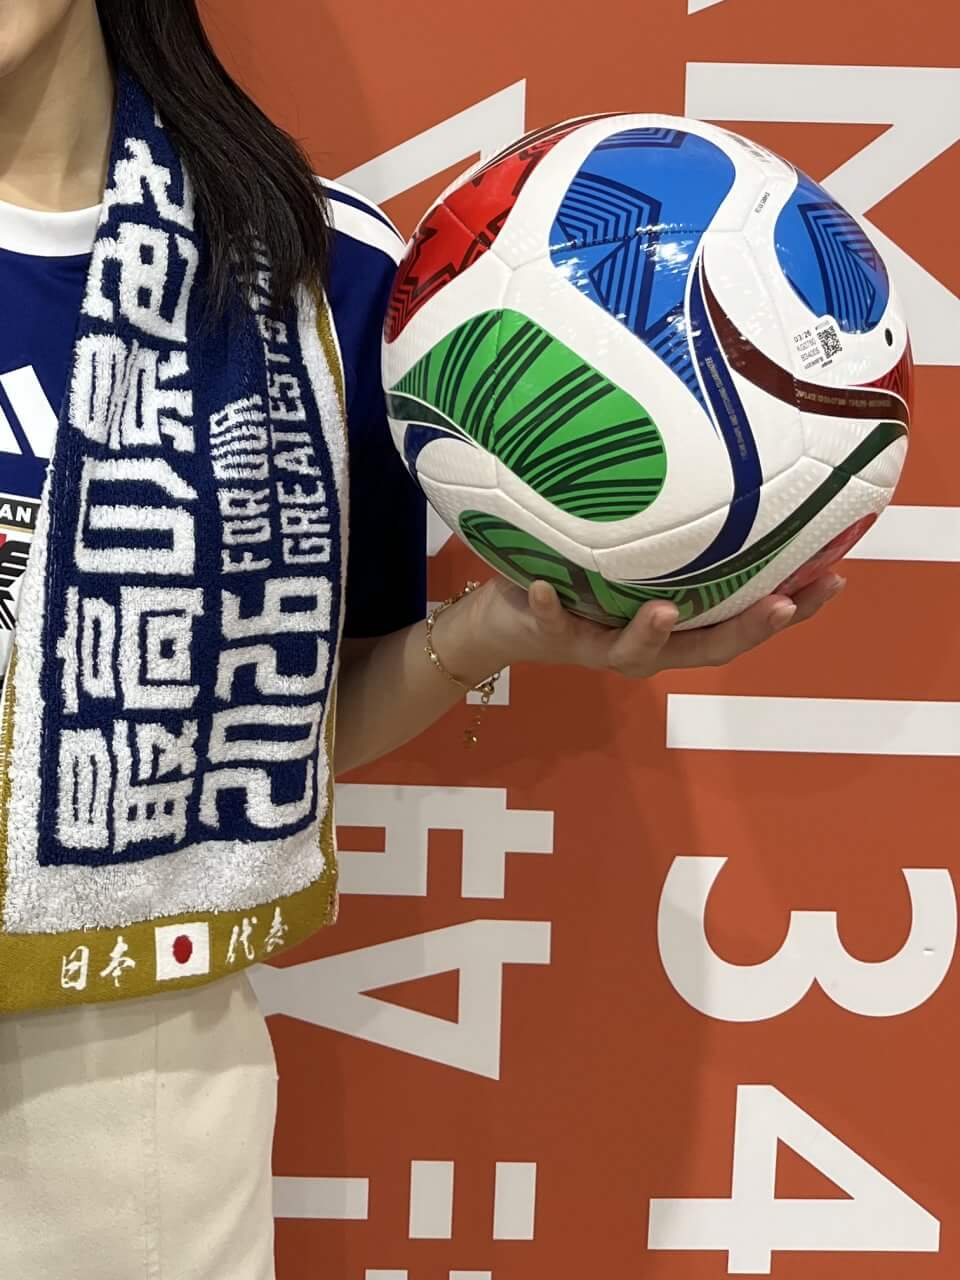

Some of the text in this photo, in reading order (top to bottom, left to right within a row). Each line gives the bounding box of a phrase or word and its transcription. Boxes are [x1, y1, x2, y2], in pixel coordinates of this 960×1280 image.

[209, 393, 272, 575] FOR OUR
[198, 575, 332, 830] 2026
[61, 907, 289, 991] 日本 代表
